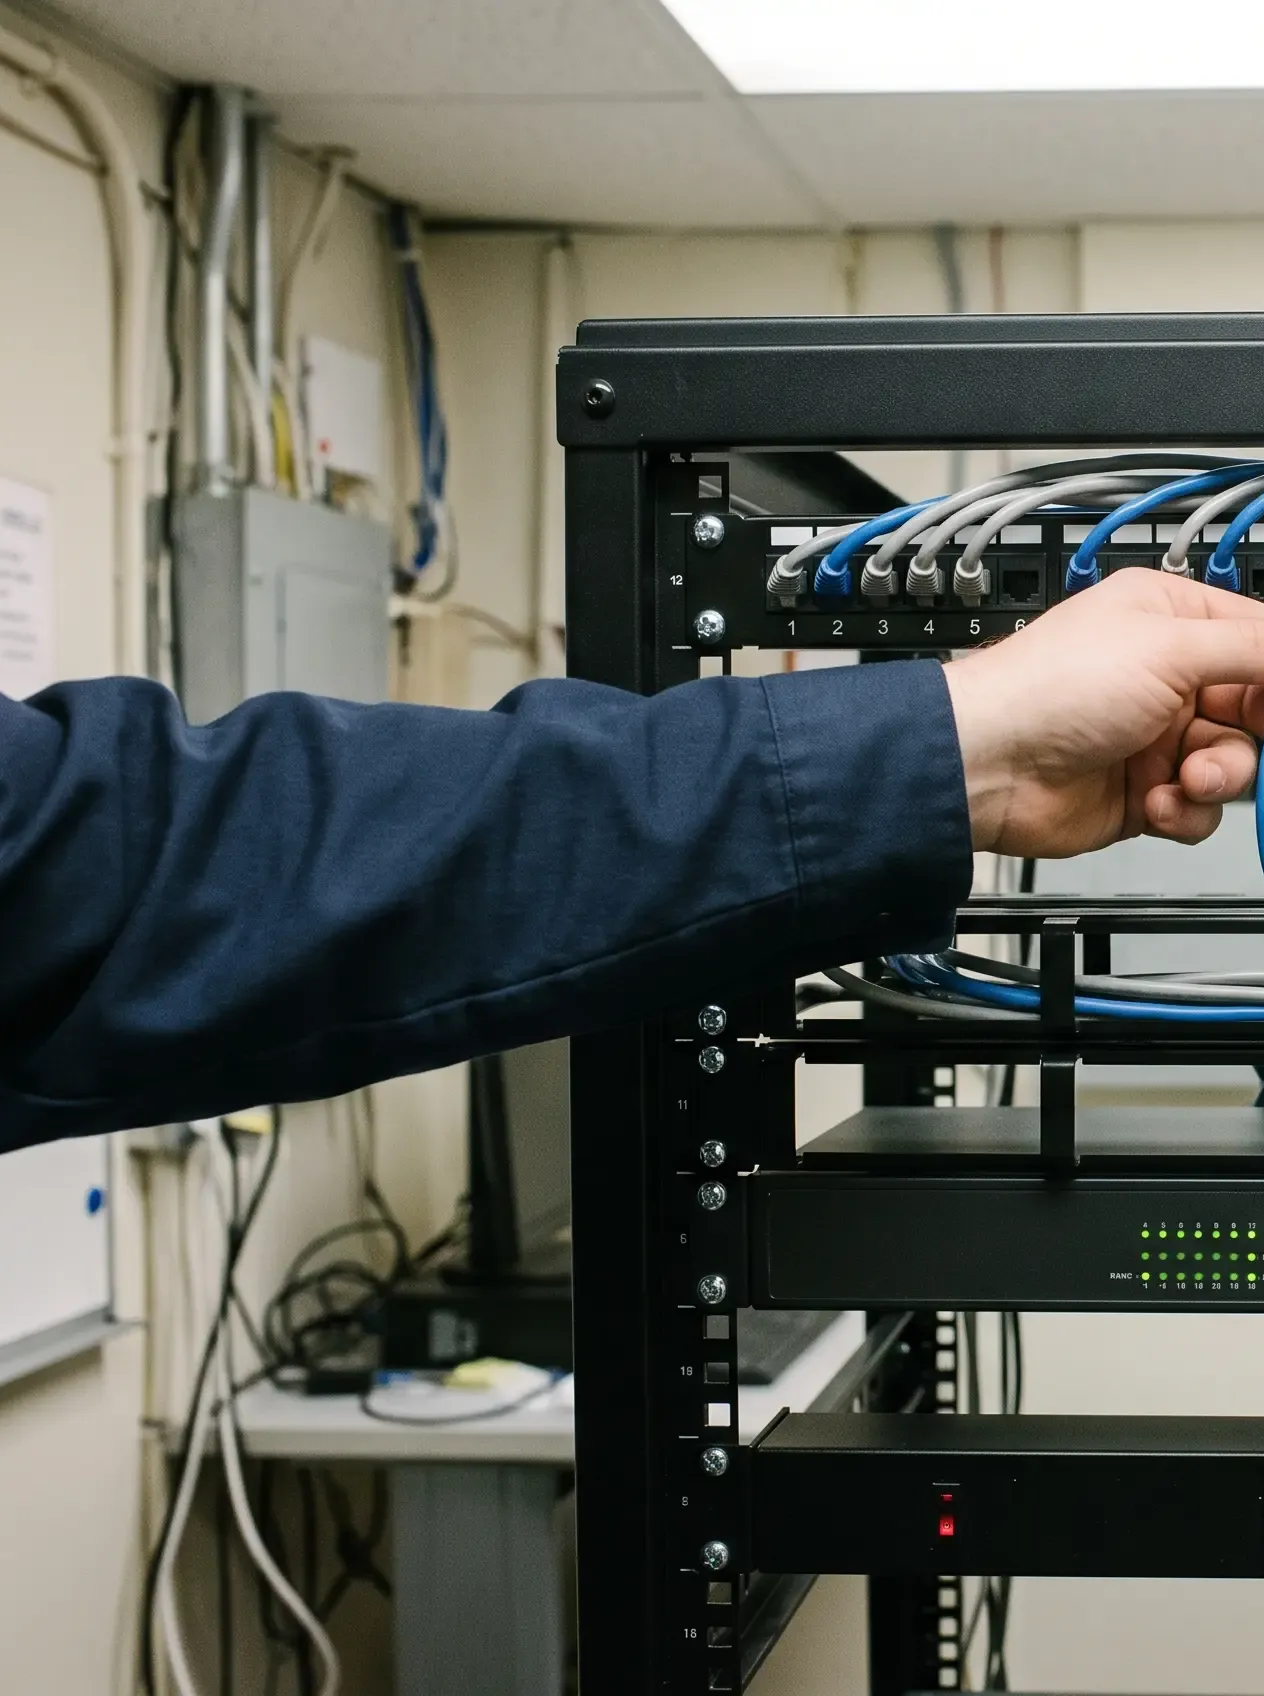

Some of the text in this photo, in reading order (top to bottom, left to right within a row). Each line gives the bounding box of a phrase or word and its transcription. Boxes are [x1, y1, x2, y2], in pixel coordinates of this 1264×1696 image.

[669, 574, 683, 586] 12
[787, 619, 795, 636] 1
[832, 619, 843, 635] 2
[878, 619, 889, 635] 3
[923, 619, 935, 635] 4
[969, 618, 981, 635] 5
[677, 1099, 688, 1110] 11
[1109, 1272, 1133, 1280] RANC
